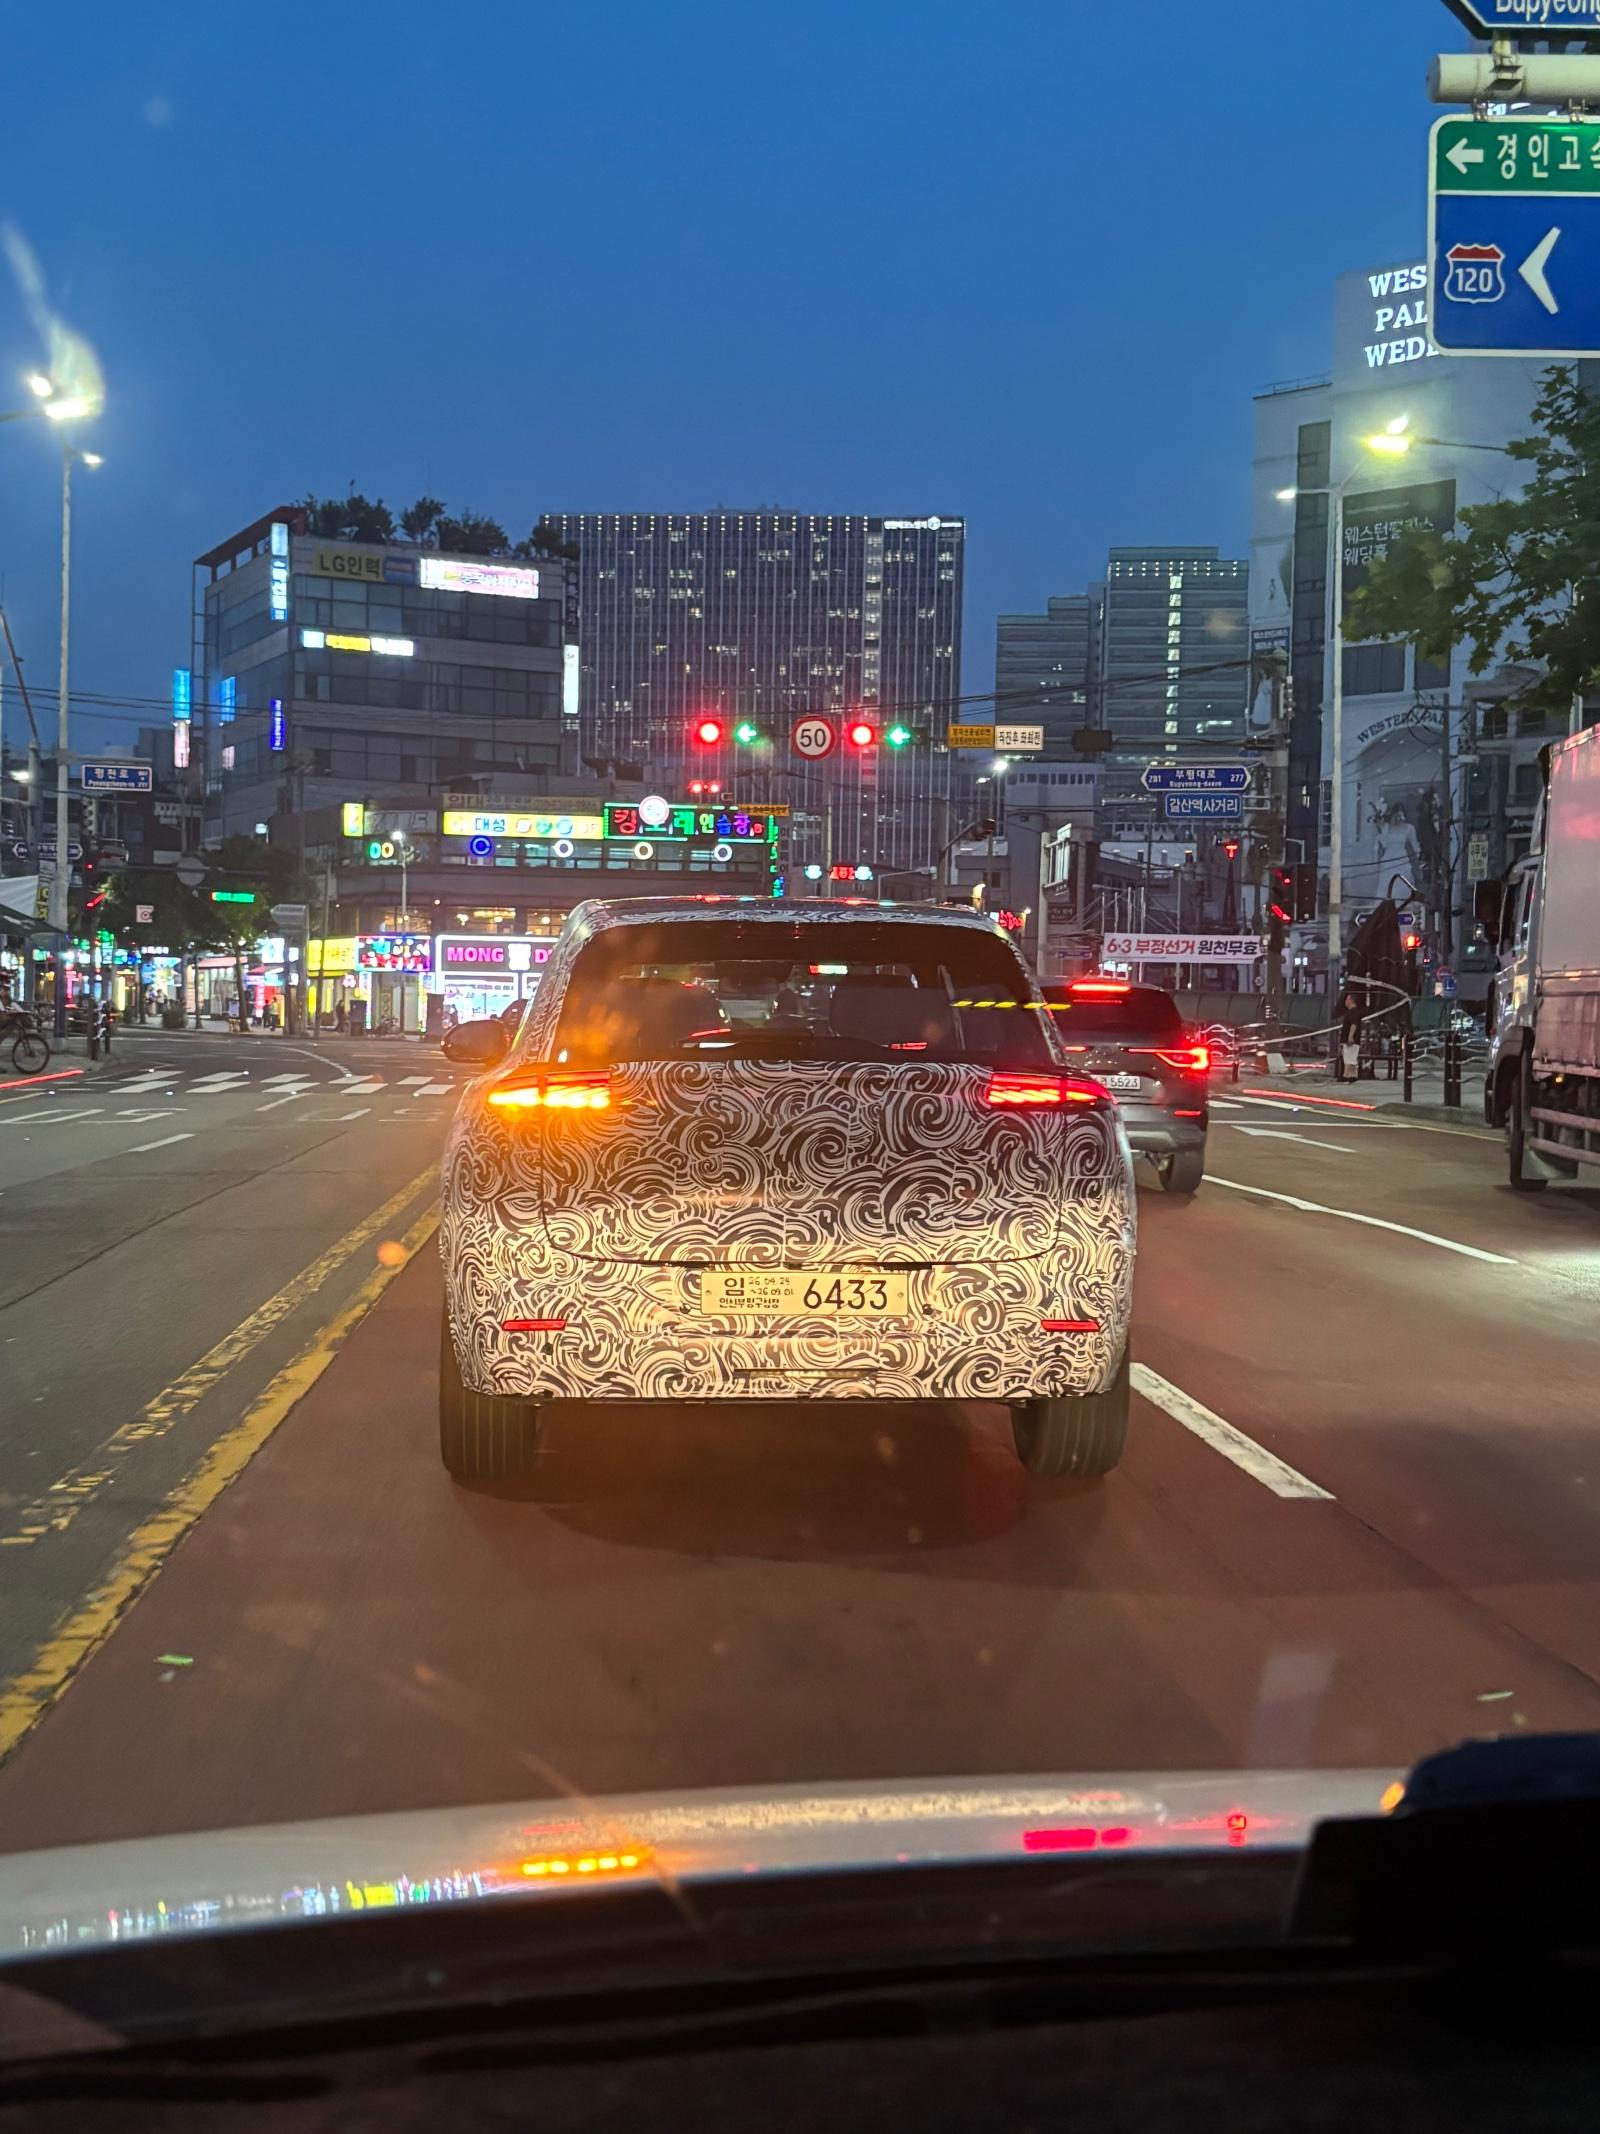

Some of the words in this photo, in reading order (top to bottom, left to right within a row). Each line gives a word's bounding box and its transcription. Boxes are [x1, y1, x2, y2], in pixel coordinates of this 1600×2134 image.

[1455, 268, 1493, 292] 120
[319, 554, 380, 579] LG인력
[799, 728, 827, 747] 50
[1175, 769, 1216, 780] 부평대로
[1169, 798, 1238, 813] 갈산역사거리
[475, 817, 505, 832] 대성
[447, 947, 504, 962] MONG
[1136, 940, 1196, 954] 부정선거
[1198, 940, 1259, 955] 원천무효
[1110, 1077, 1138, 1087] 5523
[724, 1278, 745, 1296] 임
[803, 1279, 888, 1310] 6433
